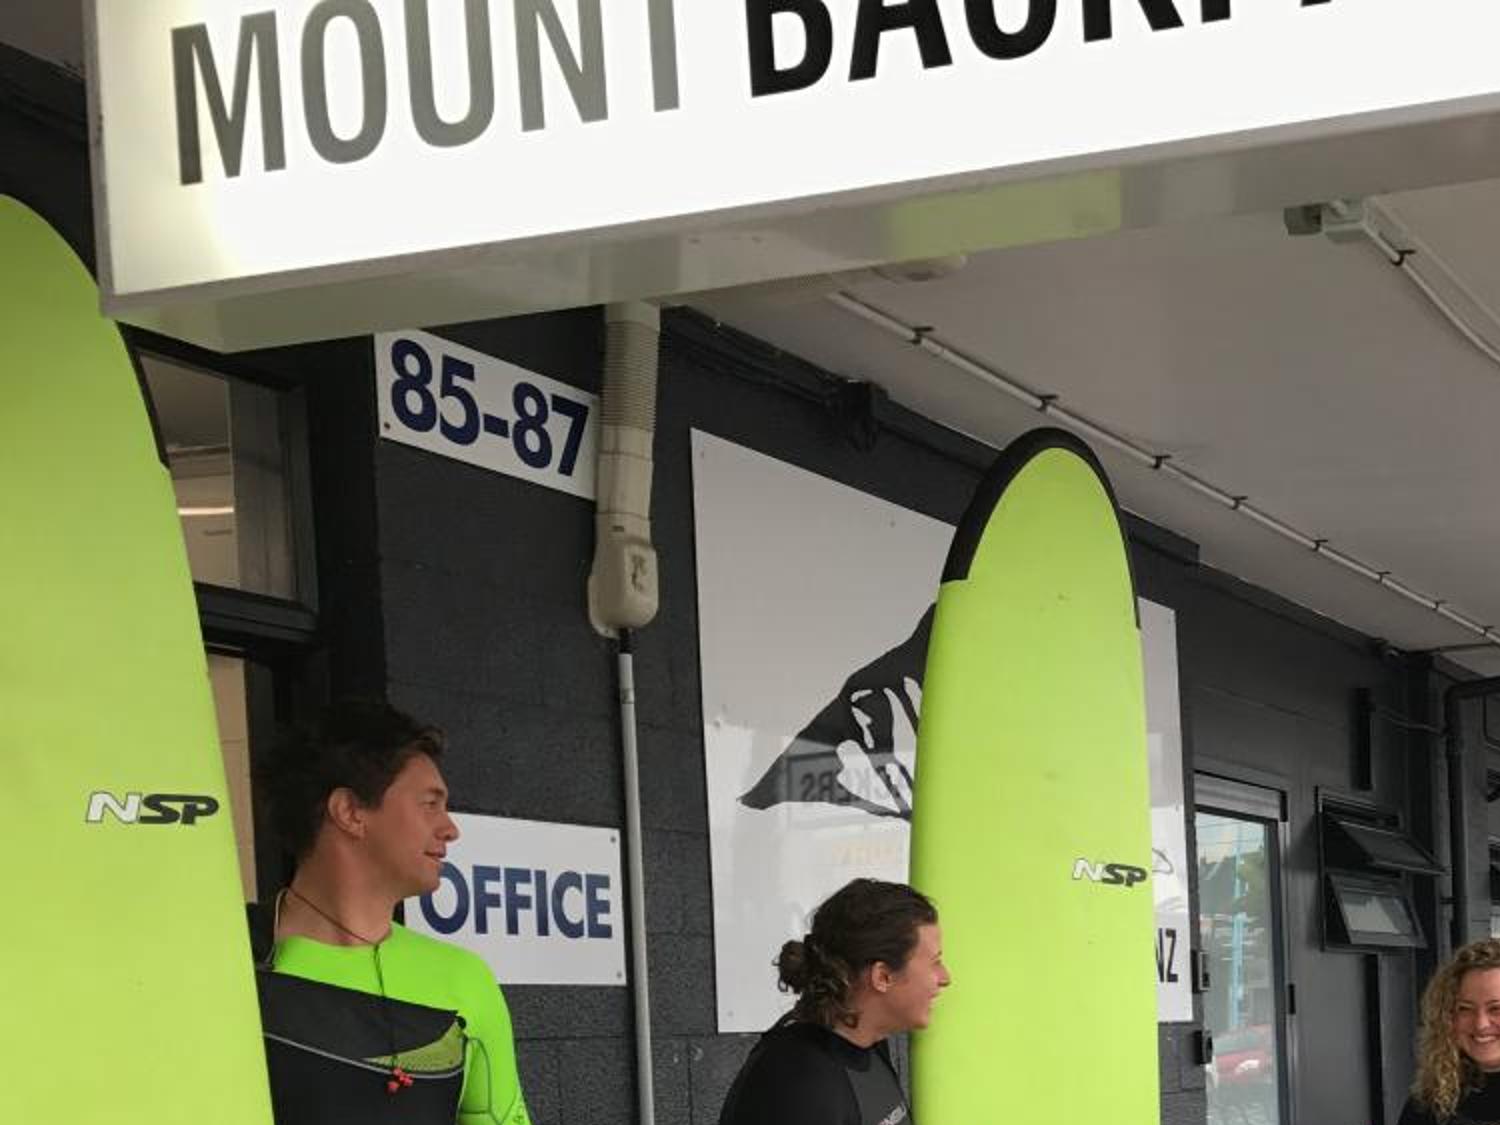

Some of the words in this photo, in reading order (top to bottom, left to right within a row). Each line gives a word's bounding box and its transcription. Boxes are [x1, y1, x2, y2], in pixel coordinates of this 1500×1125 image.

[391, 338, 589, 477] 85-87
[86, 791, 219, 825] NSP
[419, 861, 613, 939] OFFICE
[1072, 858, 1148, 887] NSP
